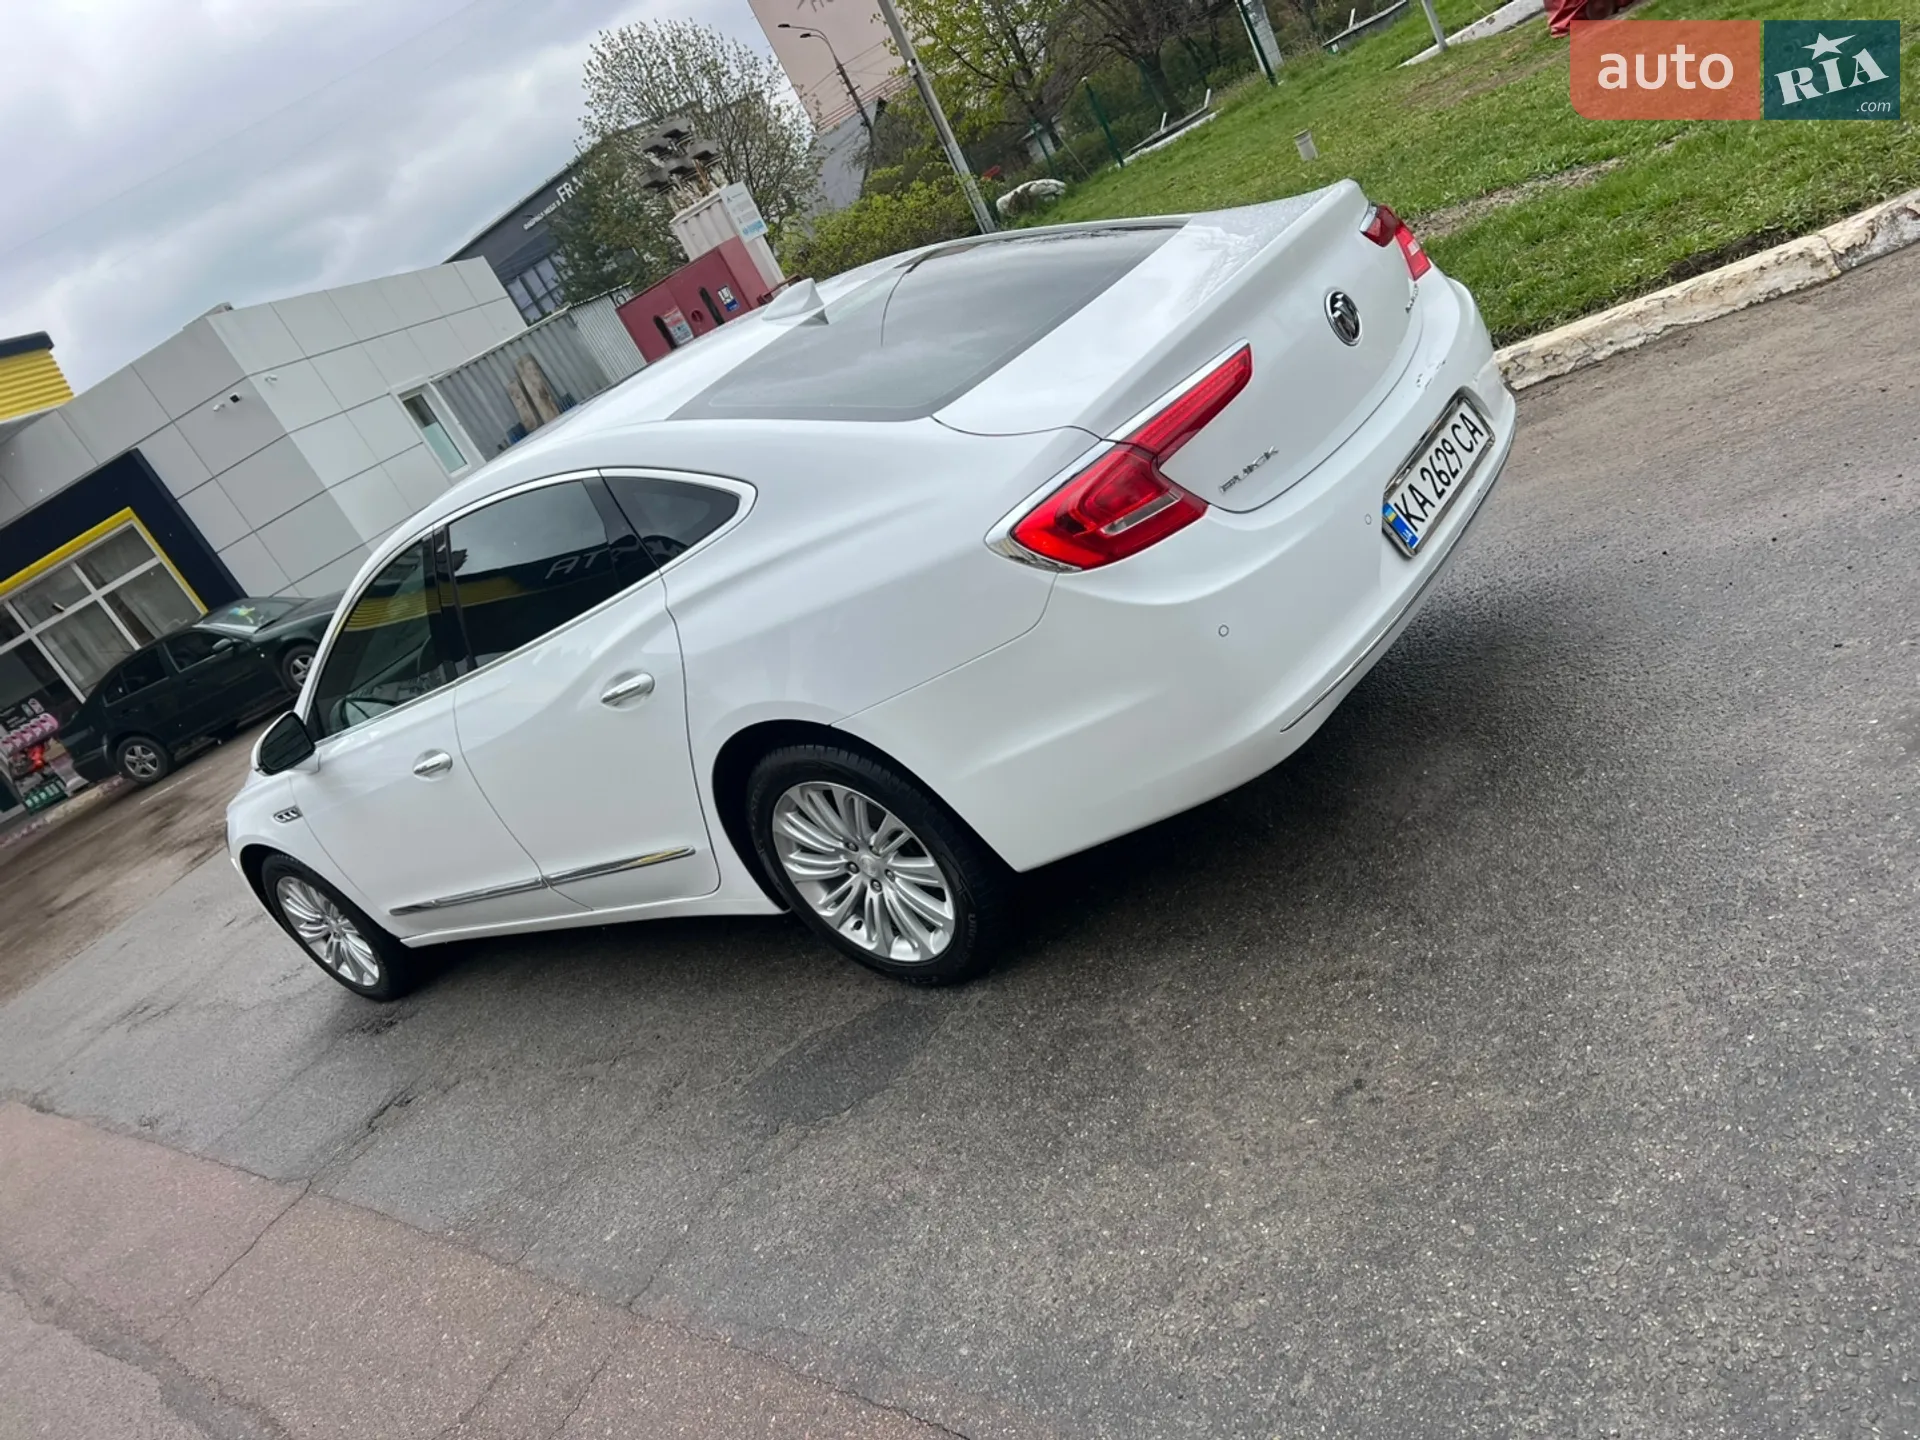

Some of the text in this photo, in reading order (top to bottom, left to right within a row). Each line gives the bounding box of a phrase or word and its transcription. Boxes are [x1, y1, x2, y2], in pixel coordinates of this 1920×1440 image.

[1394, 412, 1484, 532] KA 2629 CA
